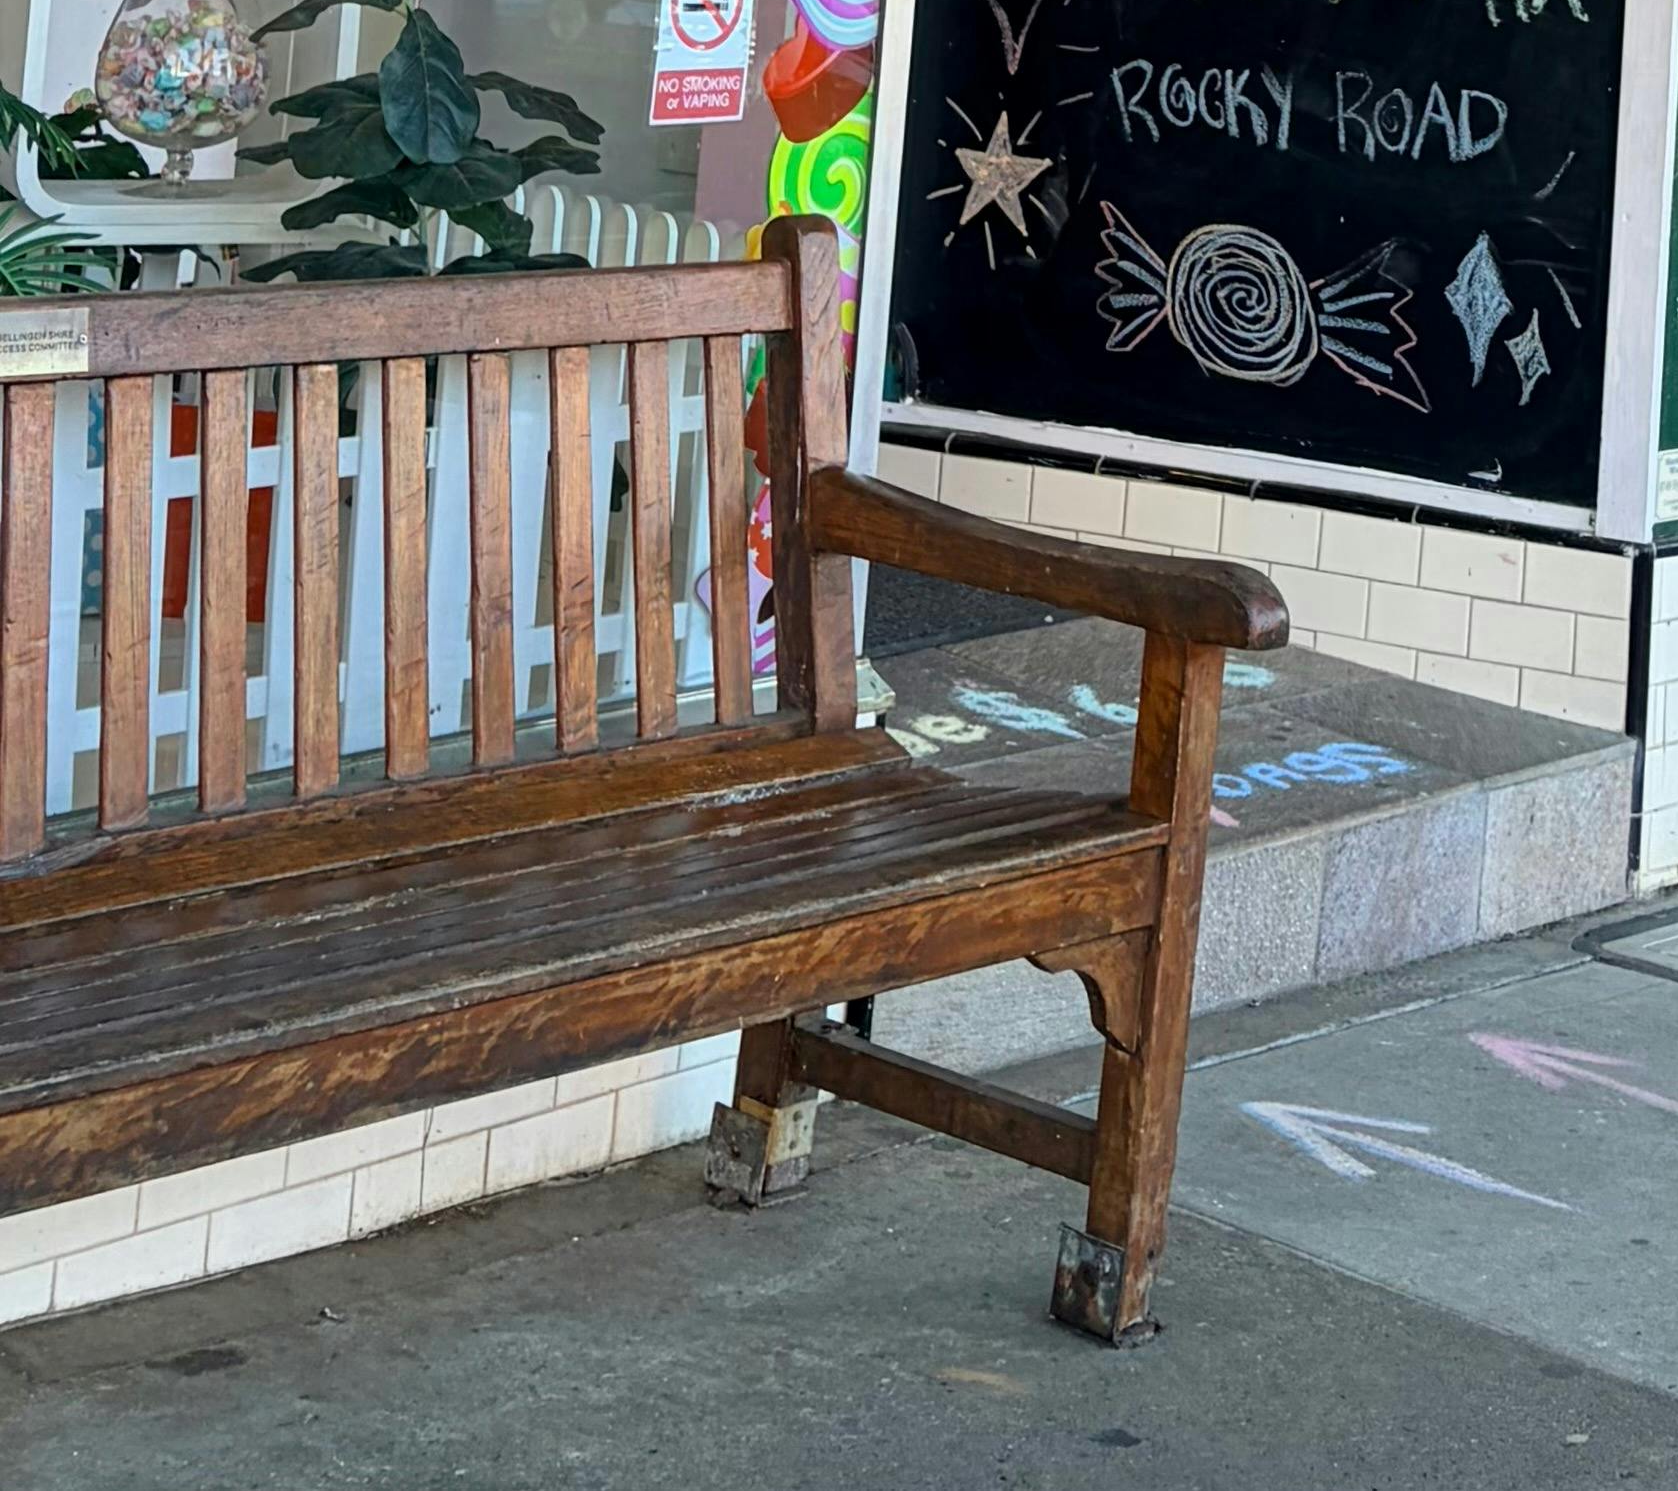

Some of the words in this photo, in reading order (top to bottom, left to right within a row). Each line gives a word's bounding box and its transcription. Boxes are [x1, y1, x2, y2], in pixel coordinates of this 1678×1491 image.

[658, 78, 679, 93] NO
[682, 75, 741, 92] SMOKING
[682, 92, 730, 109] VAPING
[1110, 58, 1296, 151] ROCKY
[1334, 71, 1509, 163] ROAD
[0, 330, 46, 342] ELLINGEN
[29, 341, 80, 352] COMMITTEE
